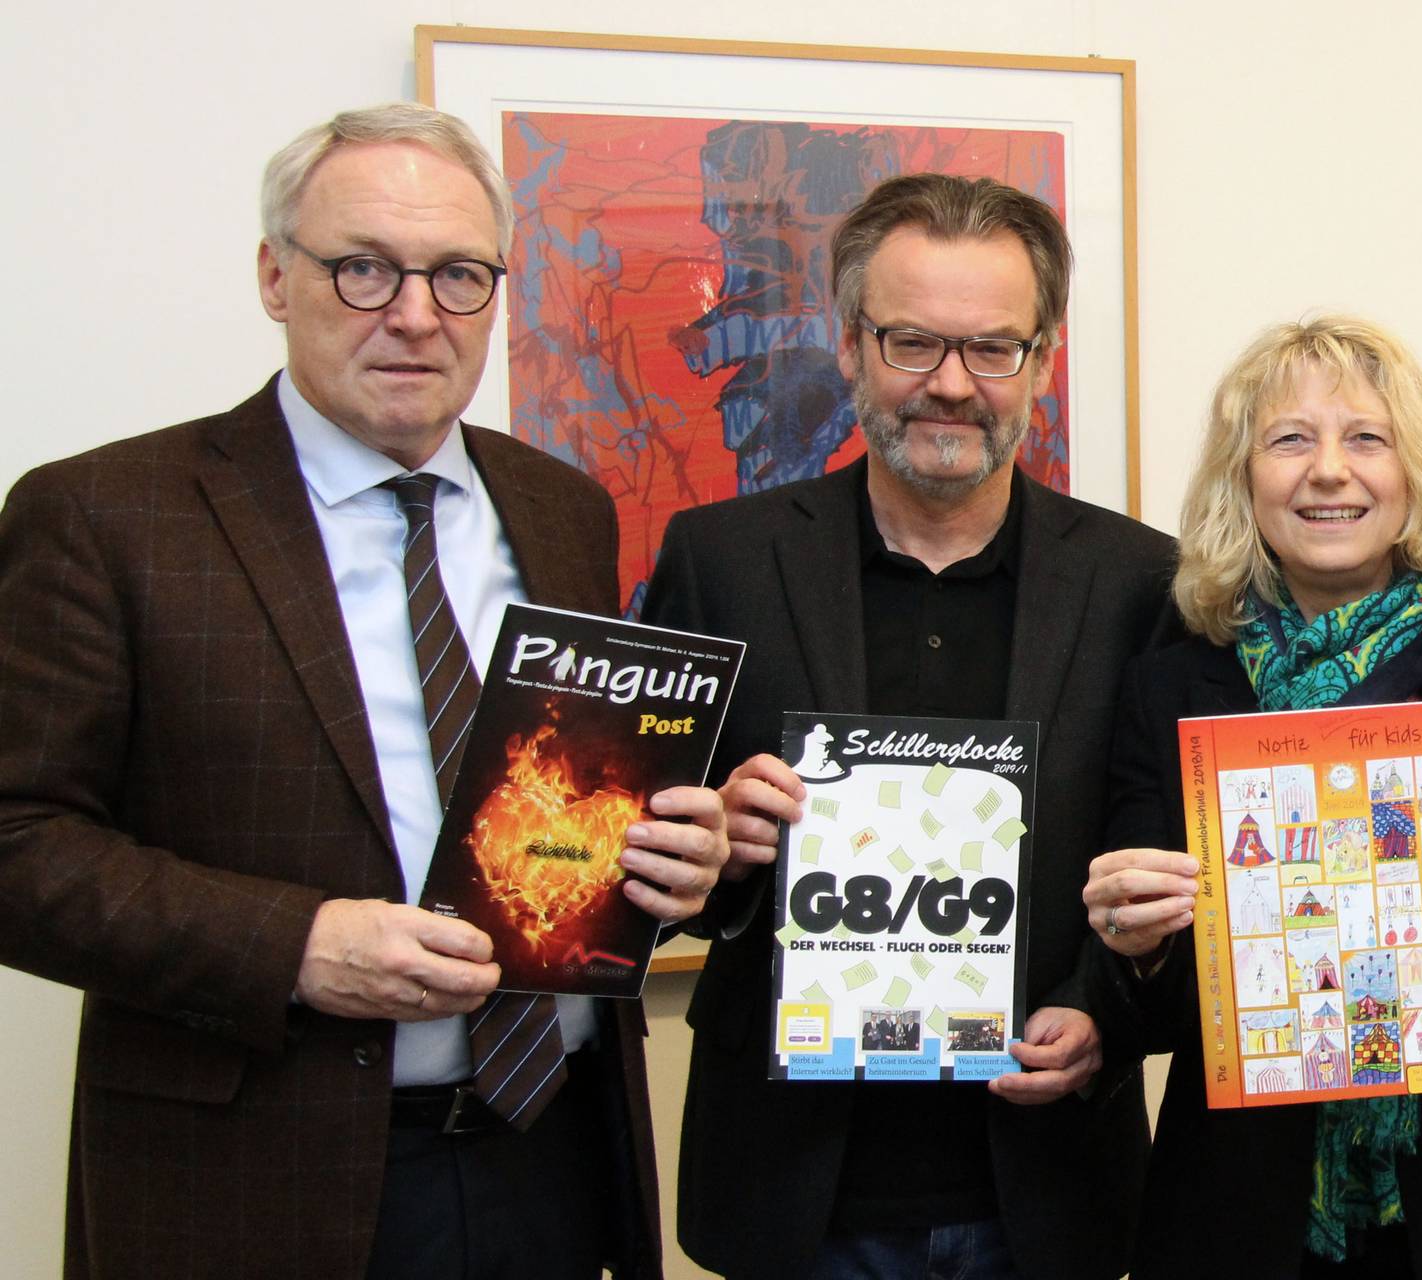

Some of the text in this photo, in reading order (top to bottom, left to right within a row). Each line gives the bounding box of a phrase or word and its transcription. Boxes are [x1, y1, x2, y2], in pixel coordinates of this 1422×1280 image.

[637, 713, 696, 735] Post
[842, 729, 1024, 765] Schillerglocke
[1257, 734, 1310, 755] Notiz
[1348, 727, 1378, 749] für
[992, 763, 1029, 774] 2019/1
[1190, 736, 1205, 785] 2018/19
[1195, 789, 1212, 878] Frauenlobschule
[1202, 881, 1213, 898] der
[789, 871, 1015, 937] G8/G9
[790, 940, 815, 951] DER
[820, 941, 876, 952] WECHSEL
[887, 942, 925, 953] FLUCH
[928, 943, 963, 953] ODER
[966, 944, 1012, 955] SEGEN?
[791, 1056, 810, 1064] Stirbt
[880, 1056, 897, 1065] Gast
[898, 1057, 908, 1065] im
[957, 1056, 973, 1065] Was
[974, 1056, 1000, 1065] kommt
[790, 1067, 853, 1076] Internet wirklich?
[957, 1068, 973, 1076] dem
[1217, 1064, 1228, 1083] Die
